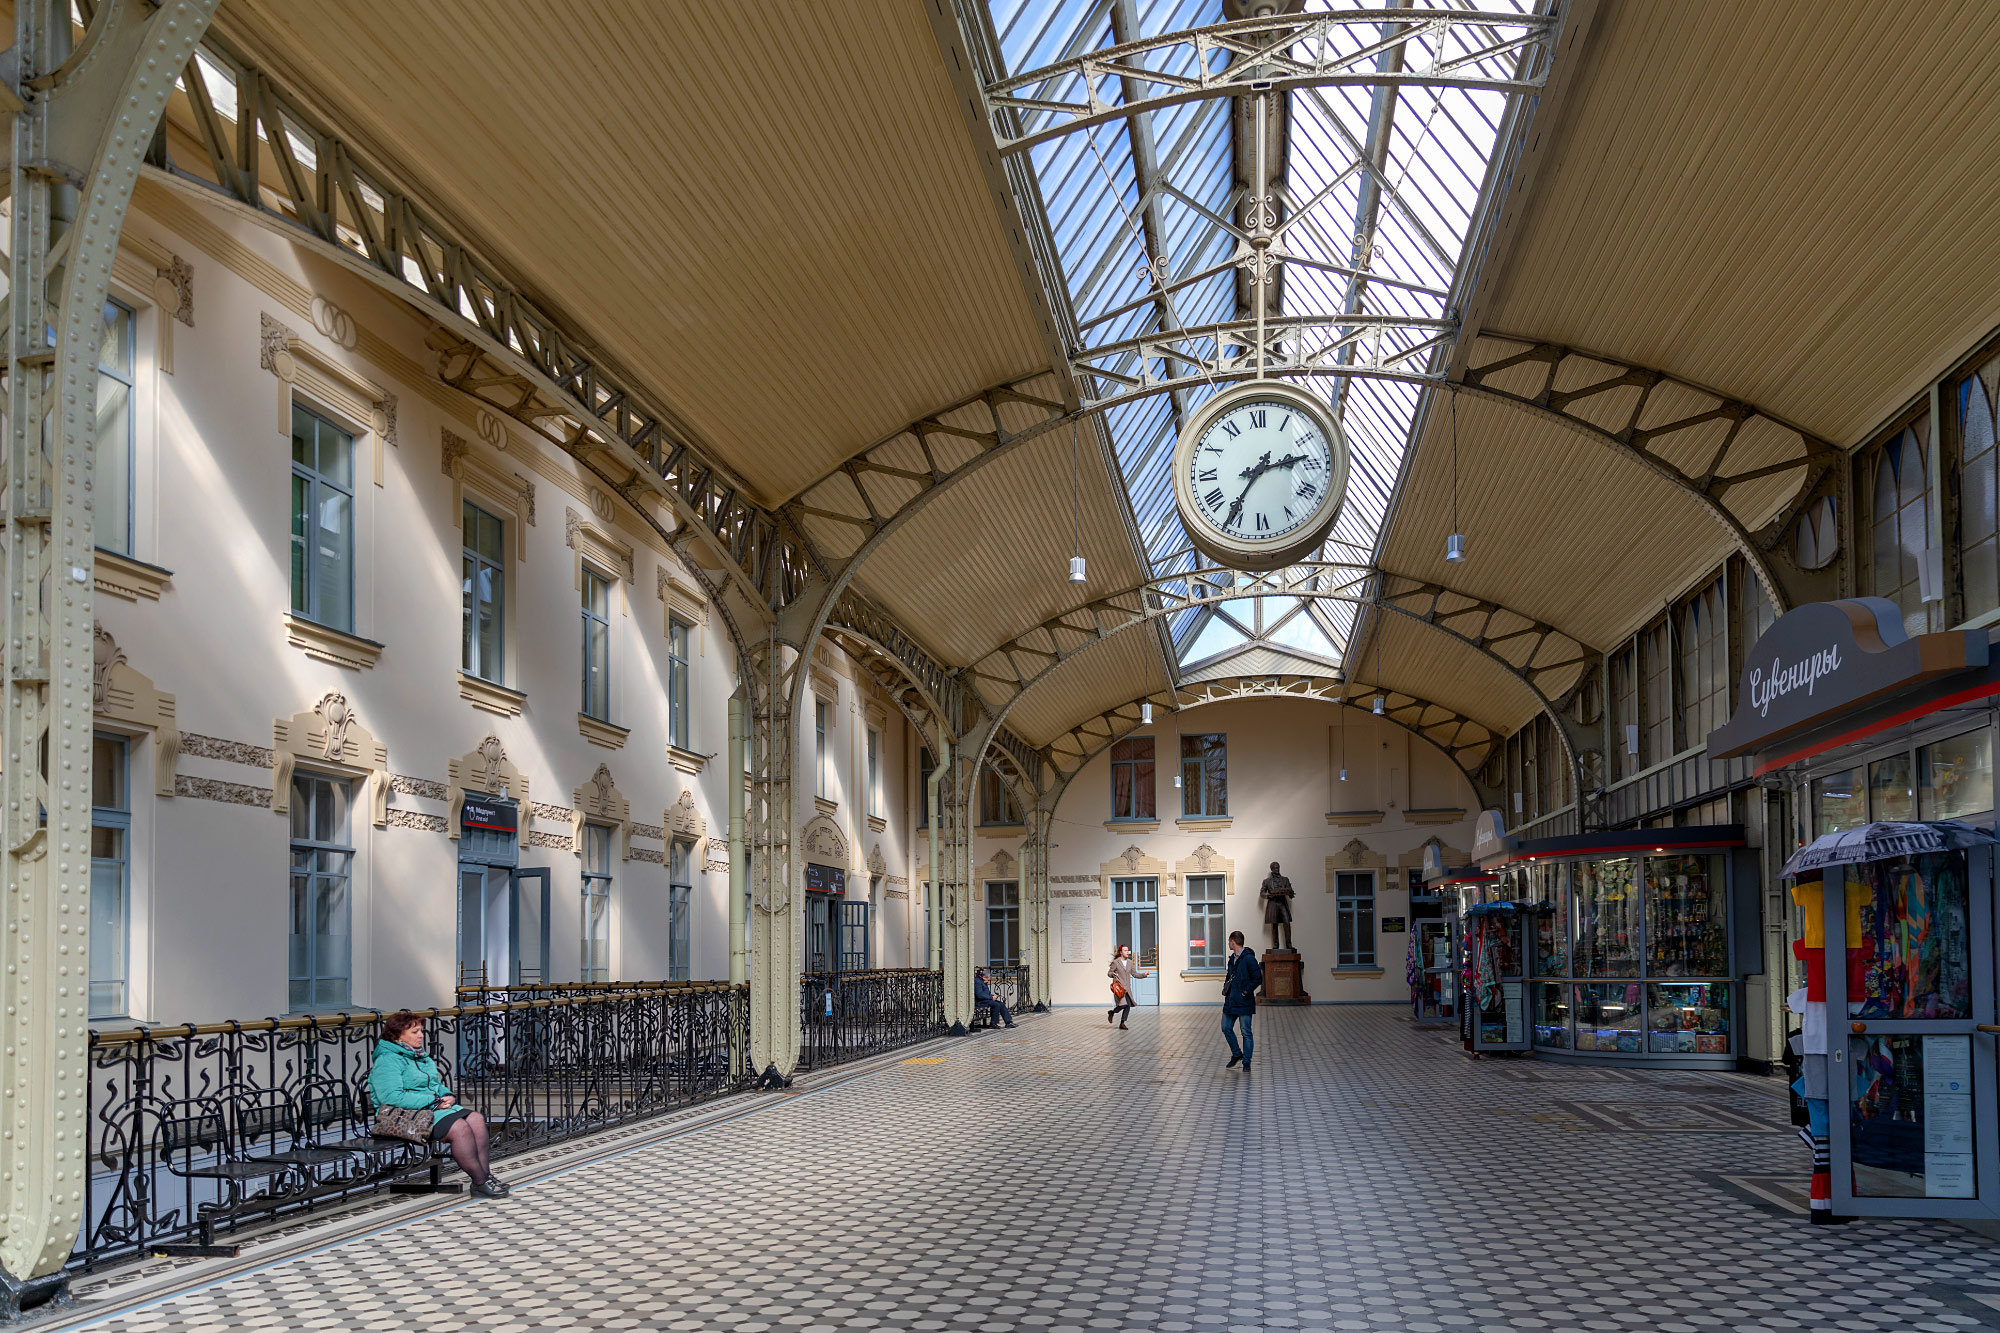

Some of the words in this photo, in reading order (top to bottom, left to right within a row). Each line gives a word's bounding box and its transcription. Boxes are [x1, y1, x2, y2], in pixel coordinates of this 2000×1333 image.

[1249, 410, 1267, 430] XII
[1222, 420, 1241, 441] XI
[1205, 443, 1224, 458] X
[1199, 466, 1218, 481] IX
[1204, 486, 1226, 514] VIII
[1255, 512, 1270, 531] VI
[1750, 644, 1842, 718] Сувениры
